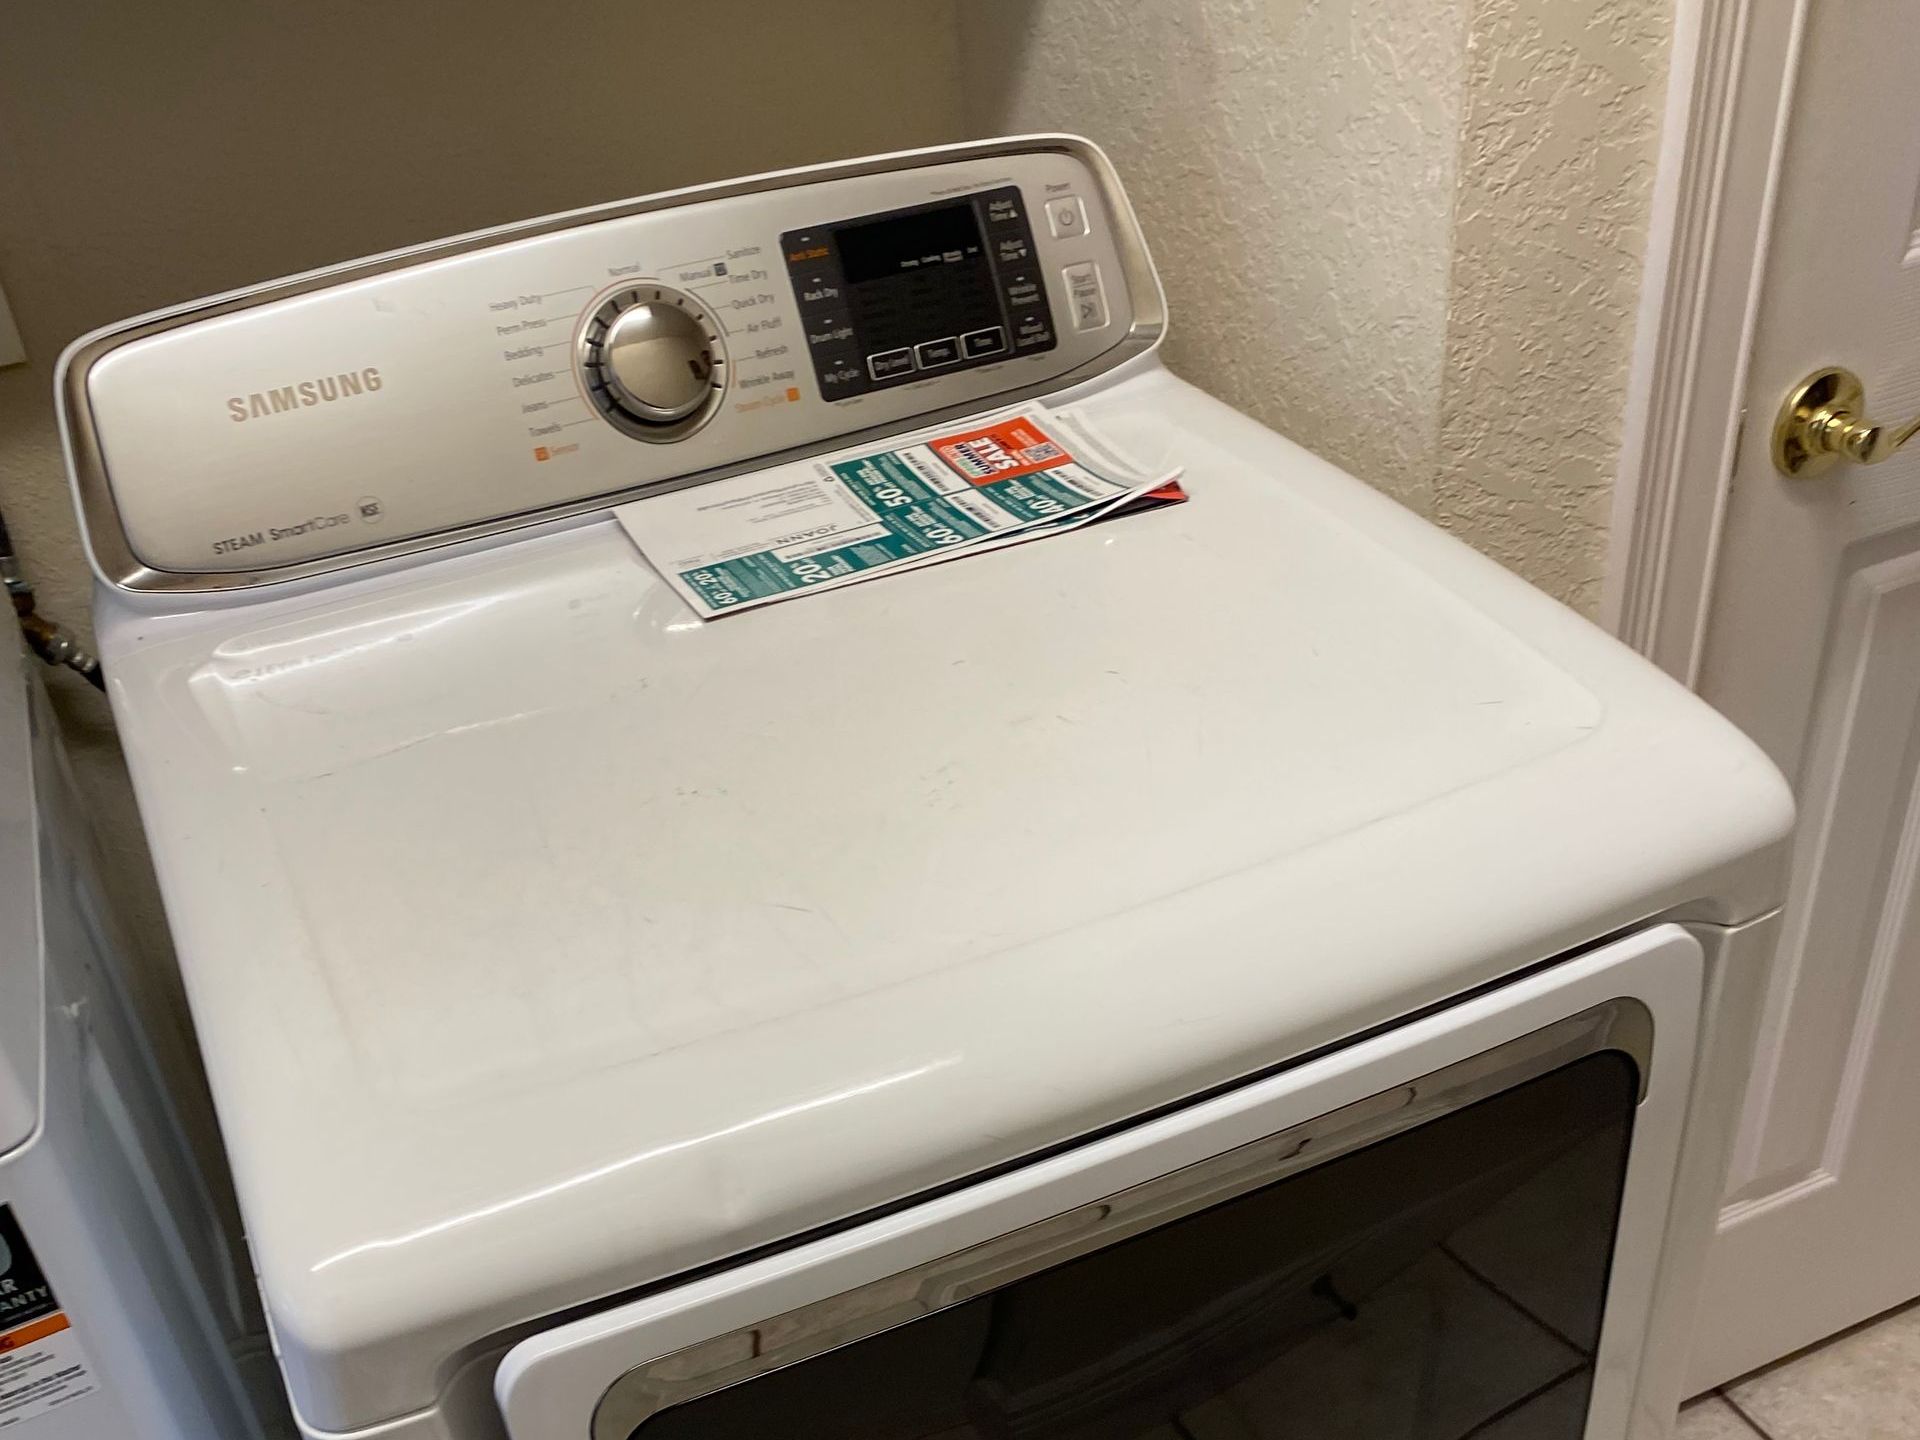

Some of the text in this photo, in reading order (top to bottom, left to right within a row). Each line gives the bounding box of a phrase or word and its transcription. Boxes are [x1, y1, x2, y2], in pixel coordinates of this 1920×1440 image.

[608, 262, 641, 276] Normal
[750, 269, 768, 281] Dry
[757, 293, 775, 305] Dry
[227, 367, 383, 422] SAMSUNG
[953, 442, 995, 476] SUMMER
[968, 435, 1019, 471] SALE
[212, 532, 267, 555] STEAM
[269, 512, 351, 541] SmartCare
[775, 524, 839, 546] JOANN
